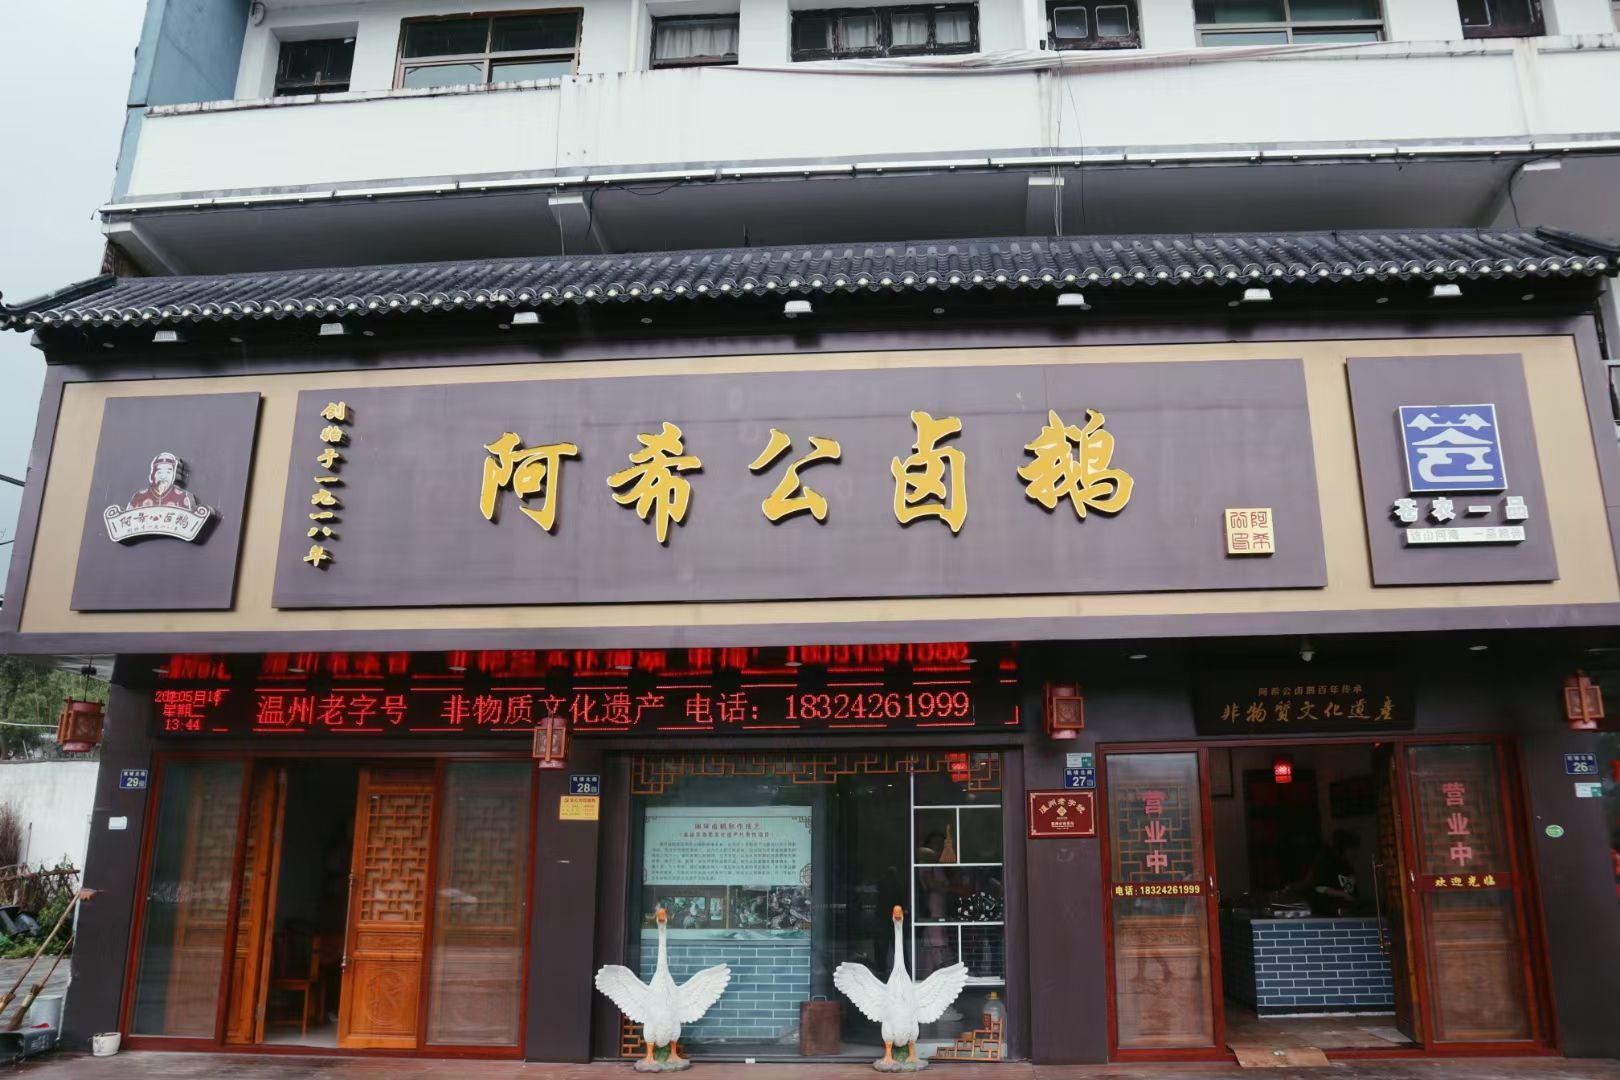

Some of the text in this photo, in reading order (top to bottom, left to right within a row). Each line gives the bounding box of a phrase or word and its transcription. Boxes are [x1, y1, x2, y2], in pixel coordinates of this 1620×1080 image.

[303, 401, 346, 567] 创始于一九一八年
[479, 410, 1134, 543] 阿希公卤鹅
[1258, 684, 1362, 697] 阿希公卤鹅百年传承
[256, 695, 408, 726] 温州老字号
[441, 693, 664, 726] 非物质文化遗产
[1573, 762, 1588, 772] 26
[127, 777, 139, 787] 29
[577, 783, 591, 793] 28
[1072, 776, 1087, 787] 27
[1039, 798, 1086, 815] 温州老字号
[1142, 790, 1168, 874] 营业中
[1442, 782, 1473, 867] 营业中
[1435, 874, 1496, 888] 欢迎光临
